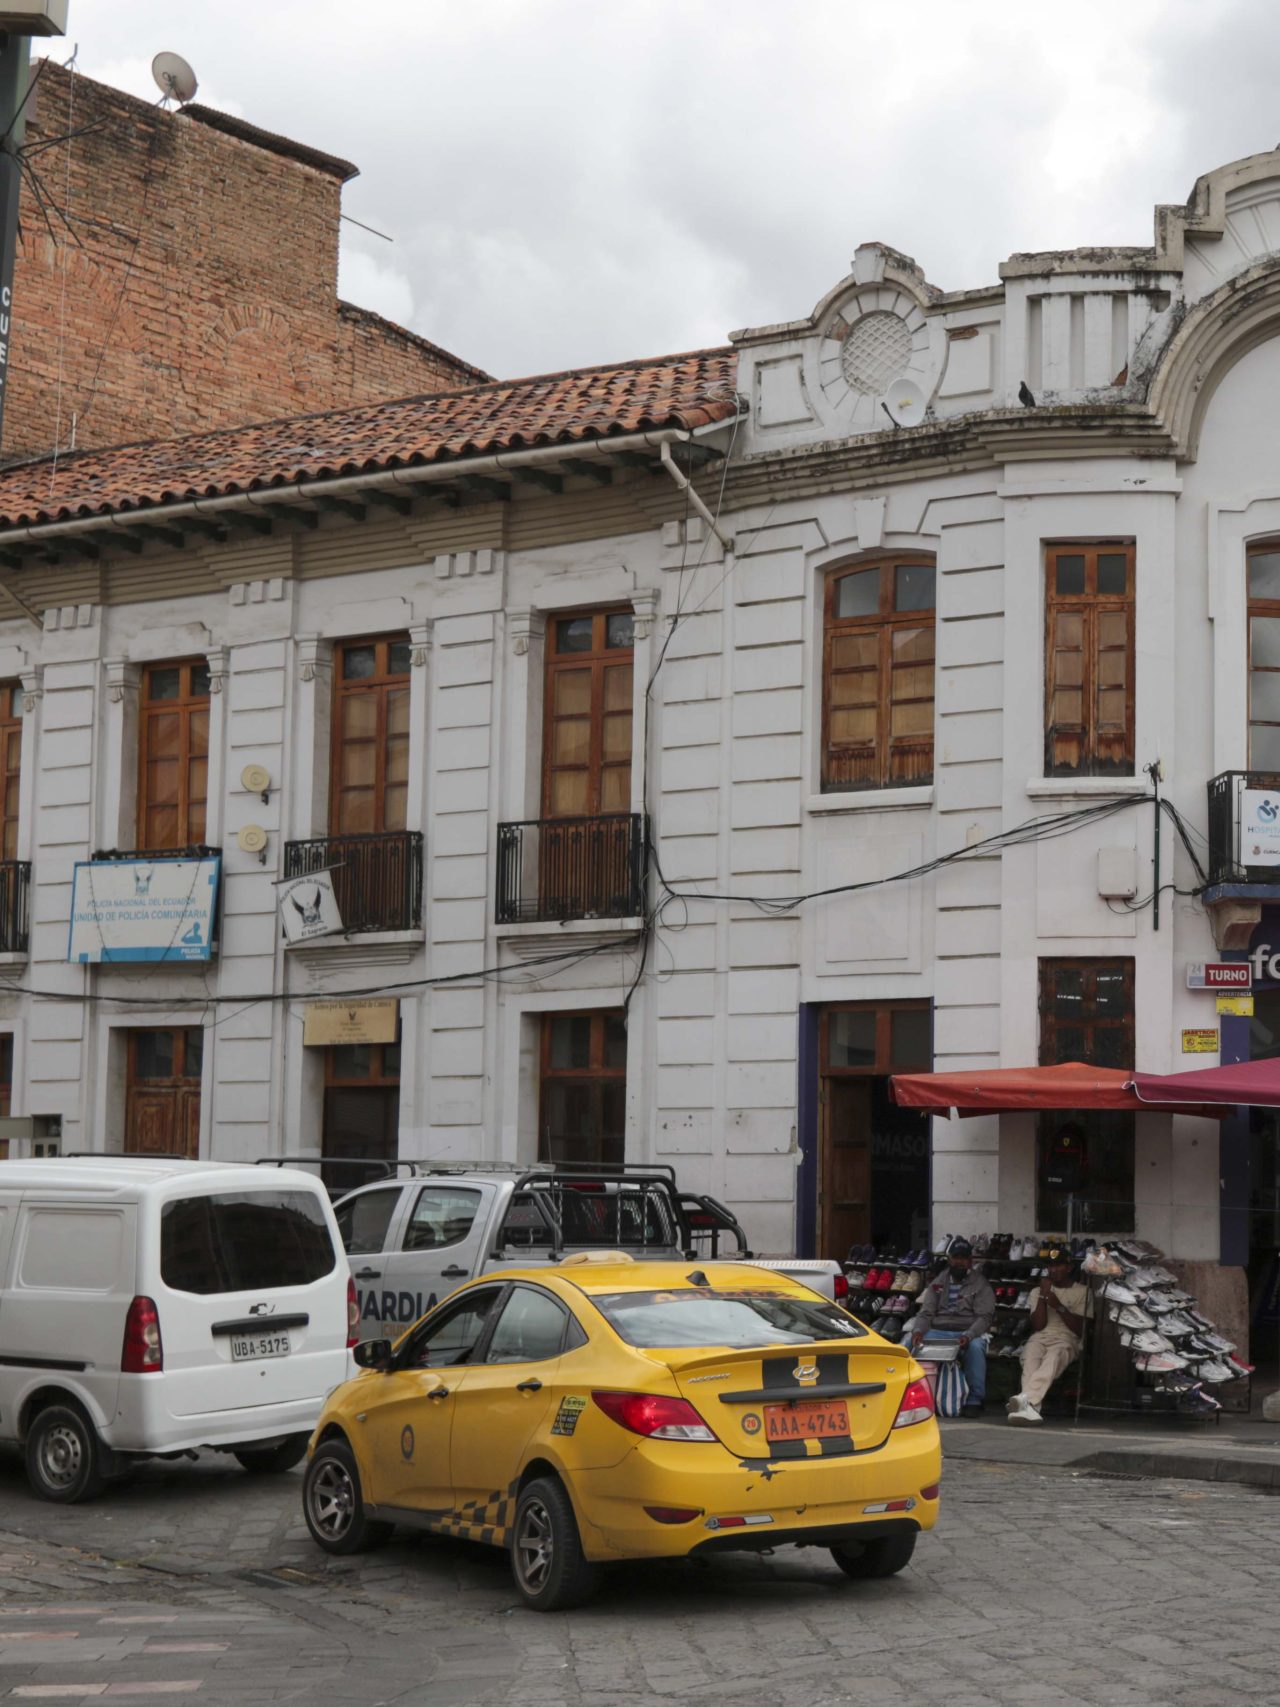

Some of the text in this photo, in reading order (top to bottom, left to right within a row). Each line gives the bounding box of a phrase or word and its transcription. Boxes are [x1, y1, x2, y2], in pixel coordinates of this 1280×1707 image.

[114, 898, 146, 907] NACIONAL
[148, 897, 161, 906] DEL
[163, 897, 196, 906] ECUADOR
[74, 913, 104, 922] UNIDAD
[105, 912, 116, 921] DE
[151, 909, 207, 921] COMUNITARIA
[1209, 970, 1247, 981] TURNO
[234, 1338, 289, 1357] UBA-5175
[770, 1412, 847, 1437] AAA-4743
